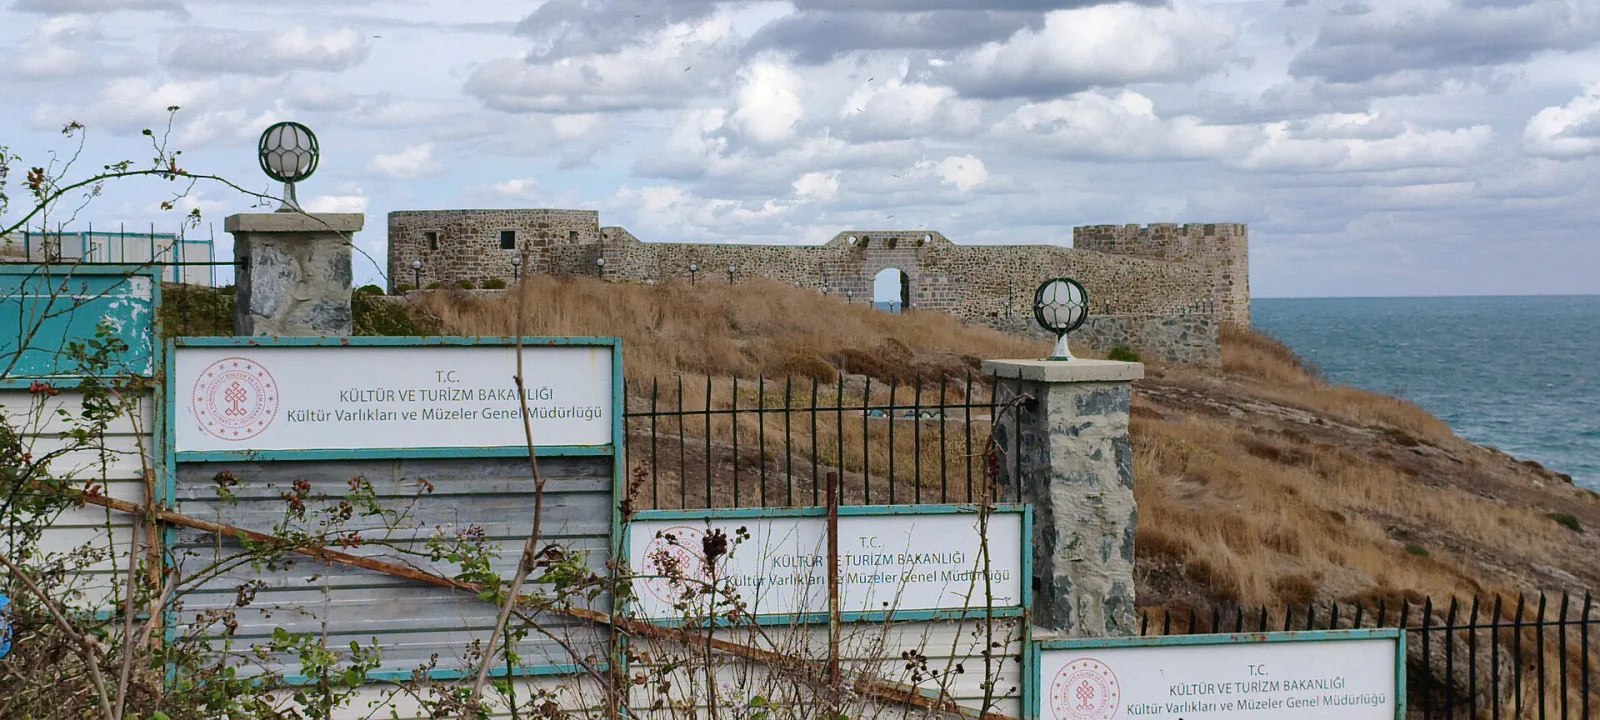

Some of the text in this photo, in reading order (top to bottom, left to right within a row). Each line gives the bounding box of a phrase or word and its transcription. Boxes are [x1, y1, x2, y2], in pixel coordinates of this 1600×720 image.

[435, 370, 460, 383] T.C.
[340, 386, 553, 402] KÜLTÜR VE TURİZM BAKANLIĞI
[287, 405, 602, 422] Kültür Varlıkları ve Müzeler Genel Müdürlüğü
[859, 536, 881, 548] T.C.
[773, 552, 823, 568] KÜLTÜR
[845, 552, 894, 566] TURİZM
[897, 551, 965, 565] BAKANLIĞI
[769, 573, 825, 585] Varlıkarı
[847, 572, 898, 584] Müzeler
[901, 570, 937, 583] Genel
[1248, 664, 1269, 676] T.C.
[1169, 675, 1345, 696] KÜLTÜR VE TURİZM BAKANLIĞI
[1127, 691, 1386, 715] Kültür Varlıkları ve Müzeler Genel Müdürlüğü
